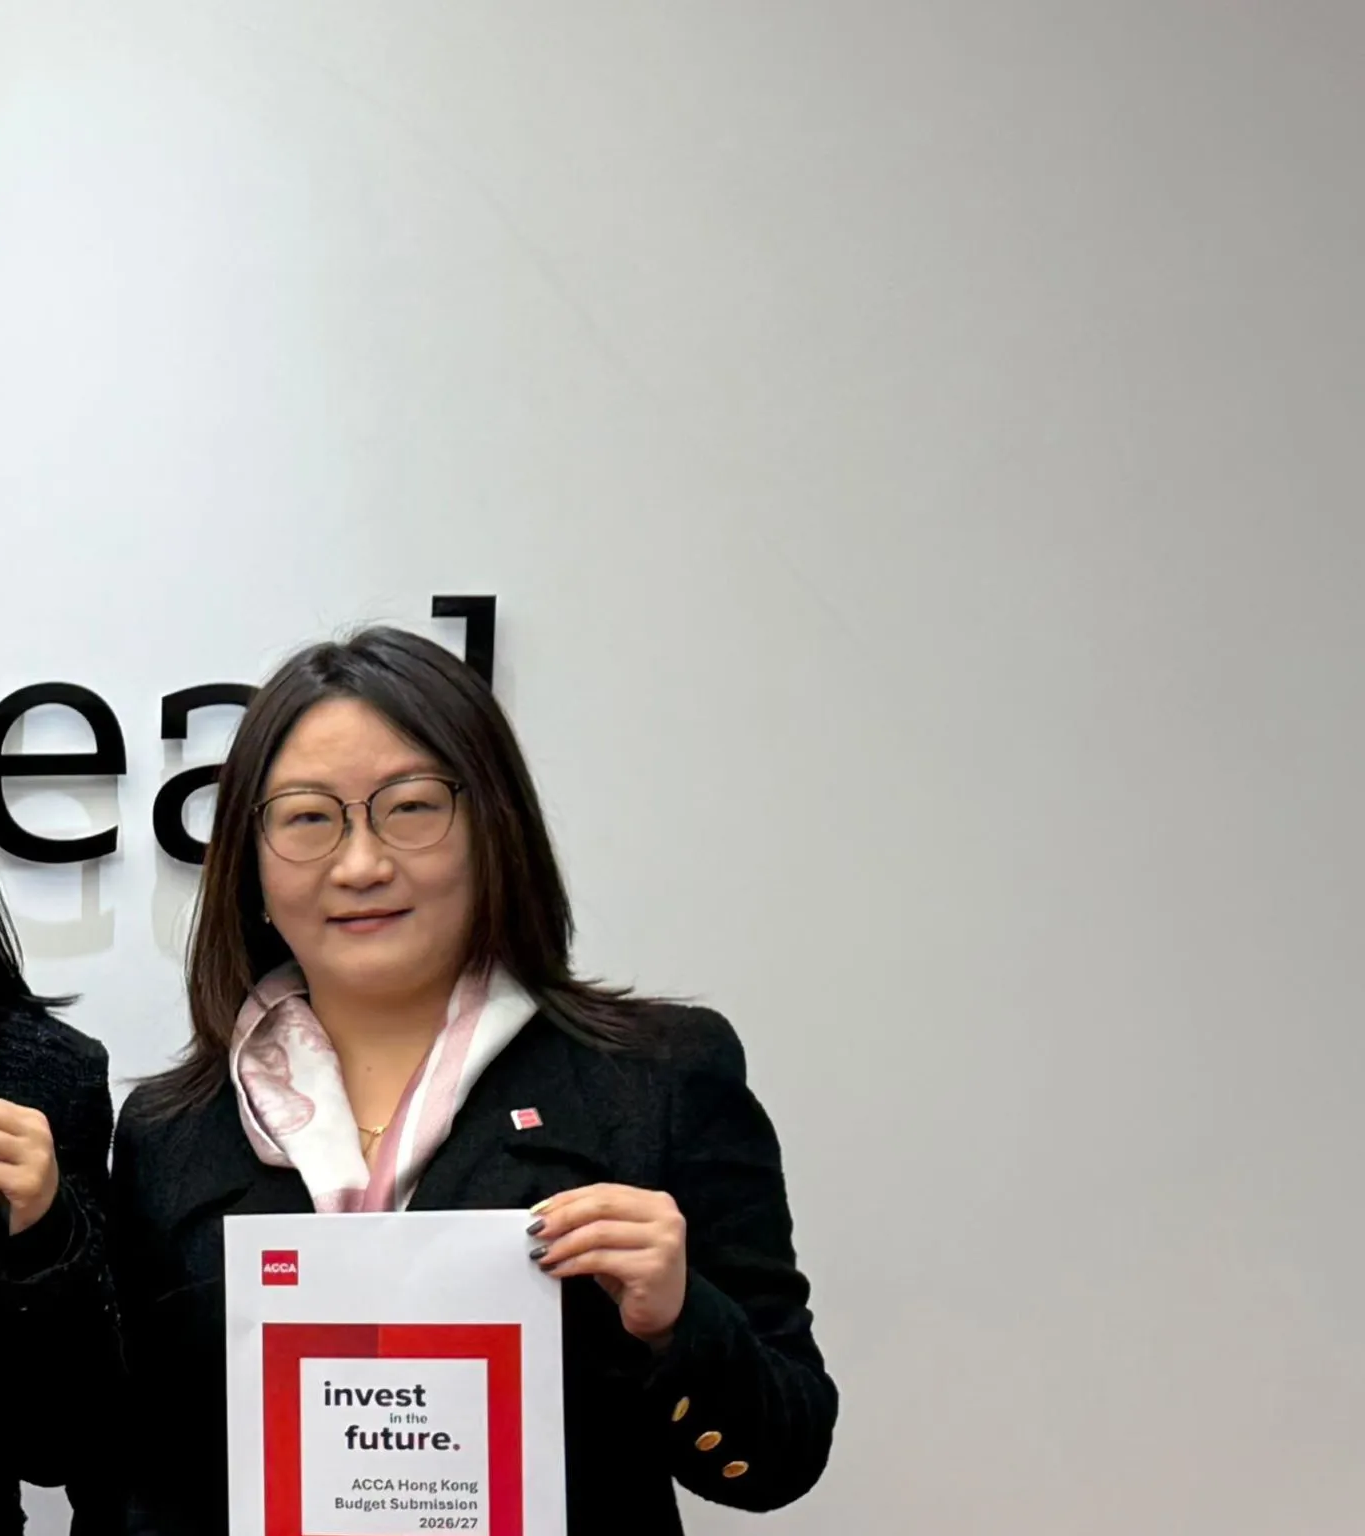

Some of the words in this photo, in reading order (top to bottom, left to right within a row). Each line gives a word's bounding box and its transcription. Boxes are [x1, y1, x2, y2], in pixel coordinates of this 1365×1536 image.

[263, 1263, 297, 1273] ACCA
[324, 1381, 427, 1408] invest
[389, 1413, 402, 1424] in
[405, 1414, 428, 1425] the
[344, 1425, 461, 1452] future.
[351, 1479, 395, 1491] ACCA
[397, 1480, 438, 1494] Hong
[440, 1480, 479, 1495] Kong
[334, 1498, 387, 1513] Budget
[389, 1498, 478, 1511] Submission
[419, 1518, 479, 1530] 2026/27
